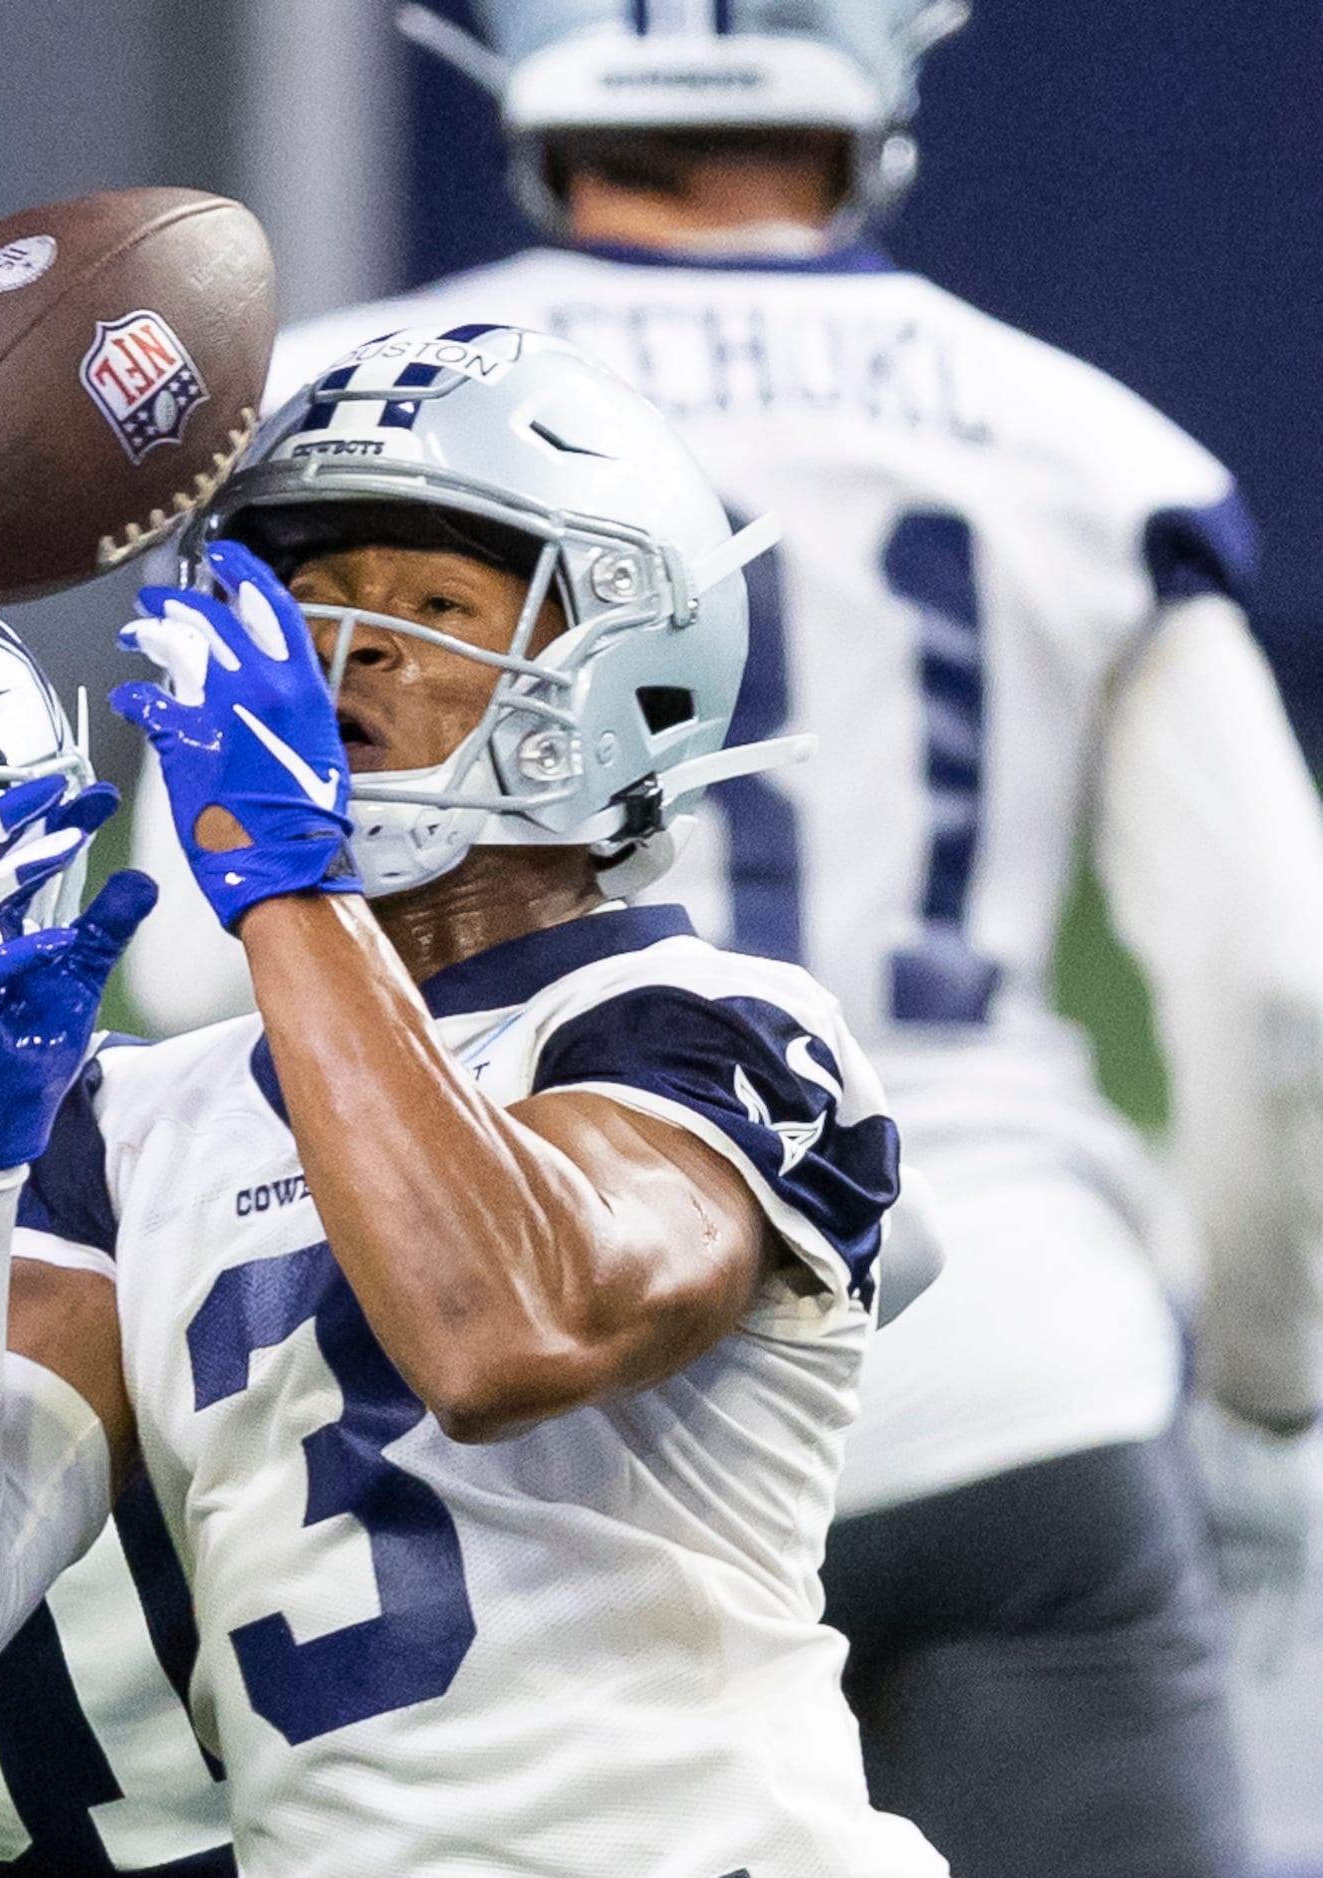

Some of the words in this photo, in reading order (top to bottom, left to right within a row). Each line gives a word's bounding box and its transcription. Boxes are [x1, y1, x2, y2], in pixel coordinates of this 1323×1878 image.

[94, 325, 177, 406] NFL
[328, 341, 498, 377] OUSTON
[186, 1240, 477, 1746] 3
